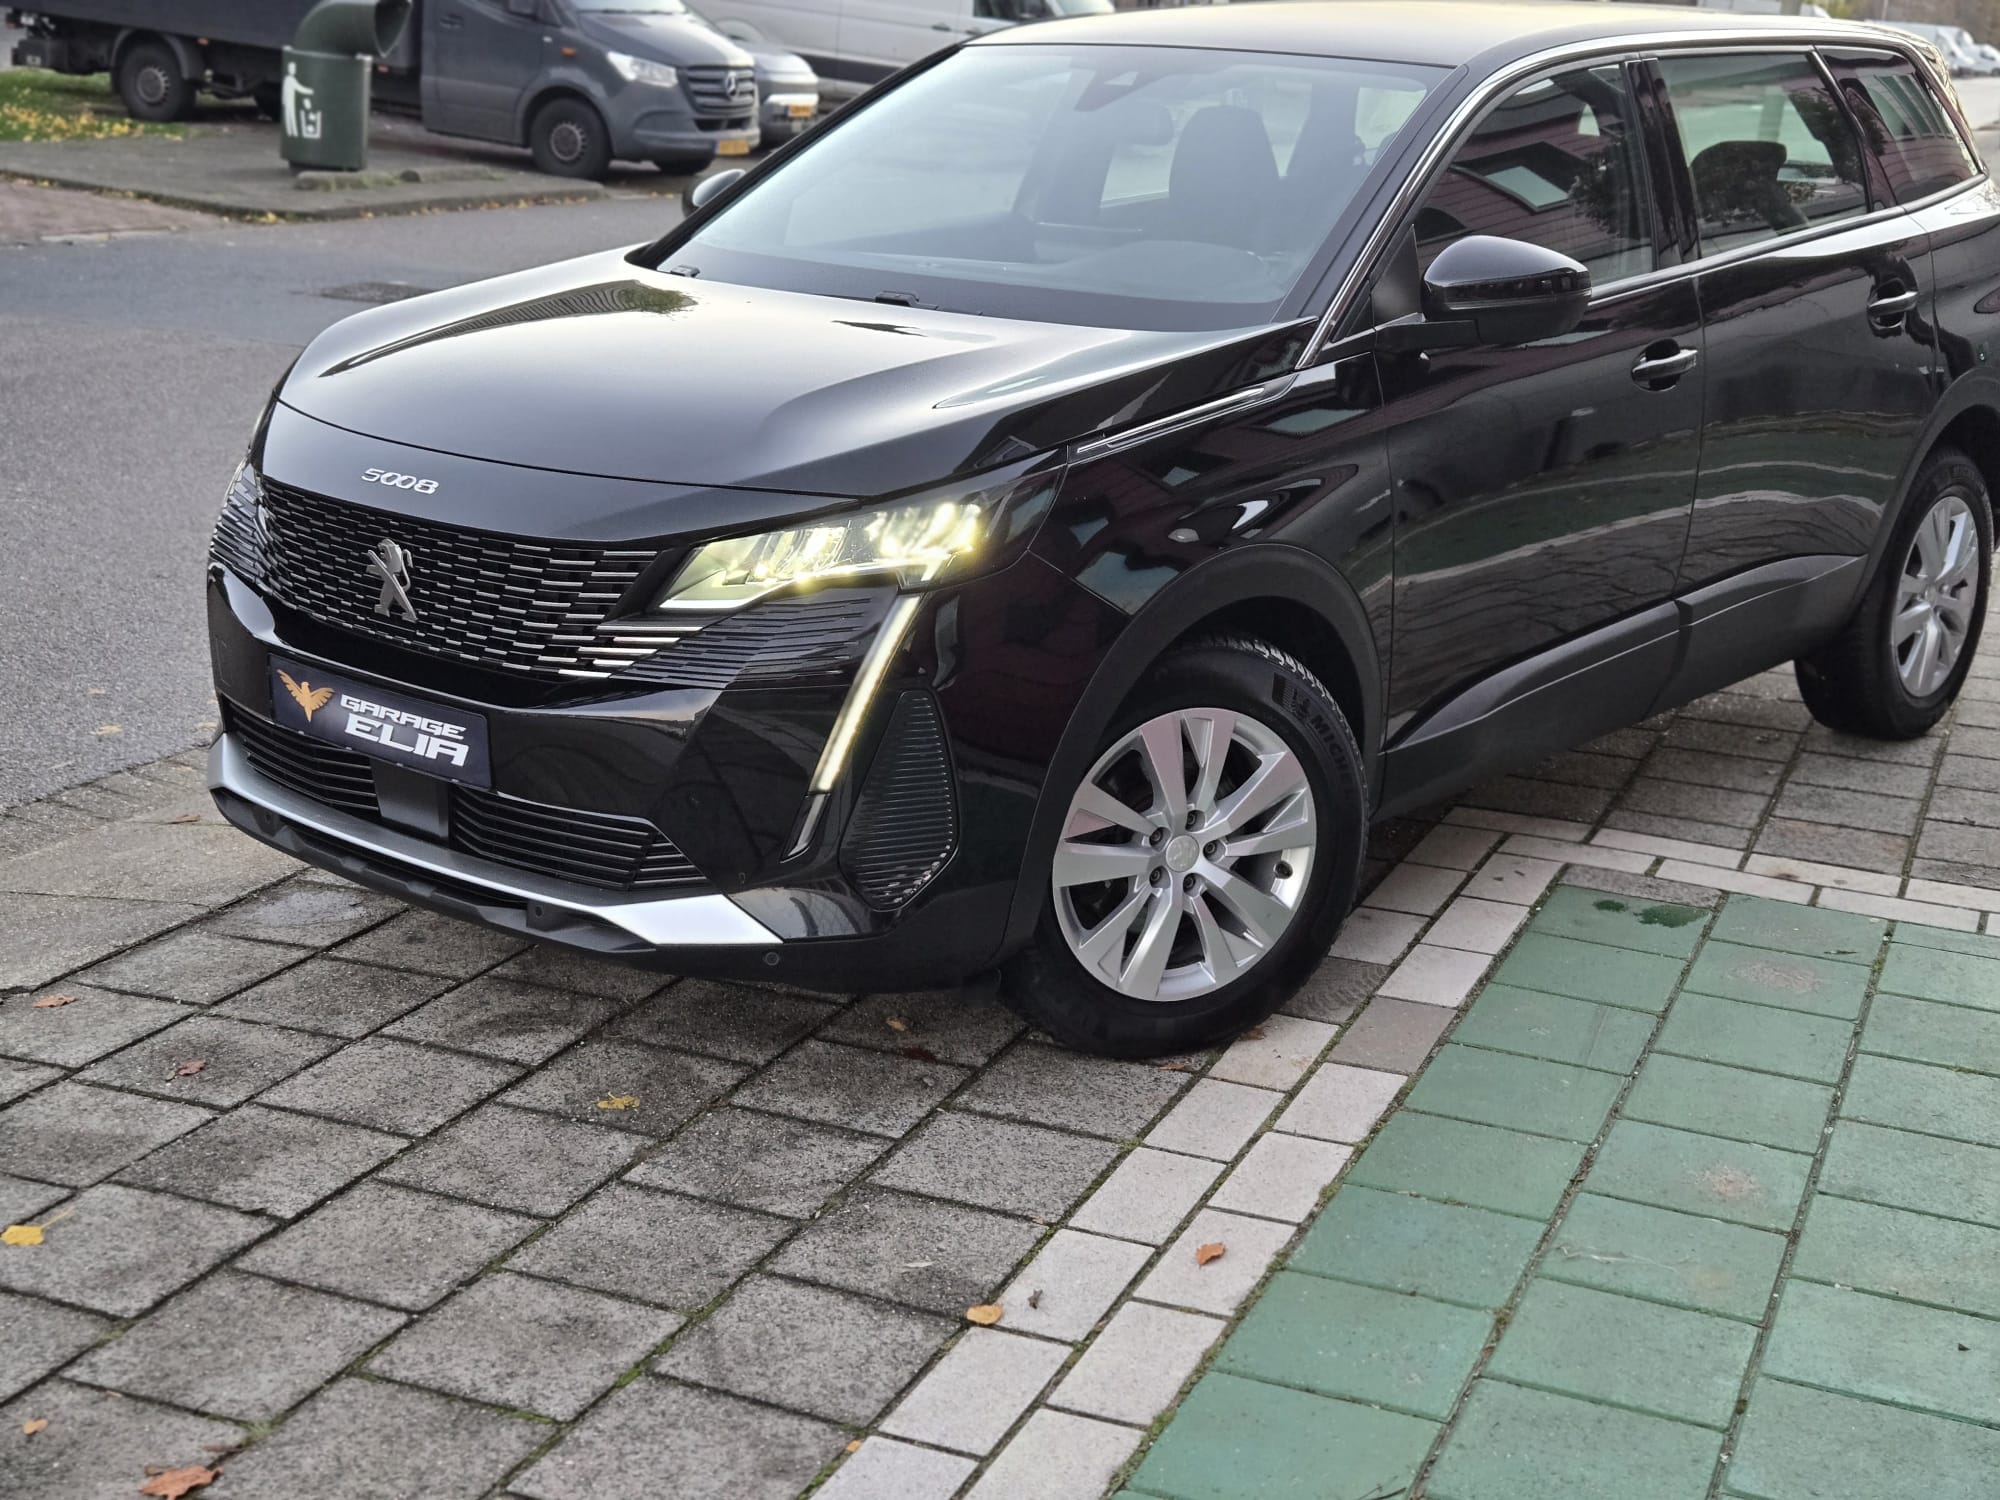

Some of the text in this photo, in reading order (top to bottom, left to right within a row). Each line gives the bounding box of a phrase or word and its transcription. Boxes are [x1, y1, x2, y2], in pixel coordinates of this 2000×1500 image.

[361, 468, 439, 494] 5008
[340, 694, 467, 740] GARAGE
[344, 713, 469, 767] ELIA
